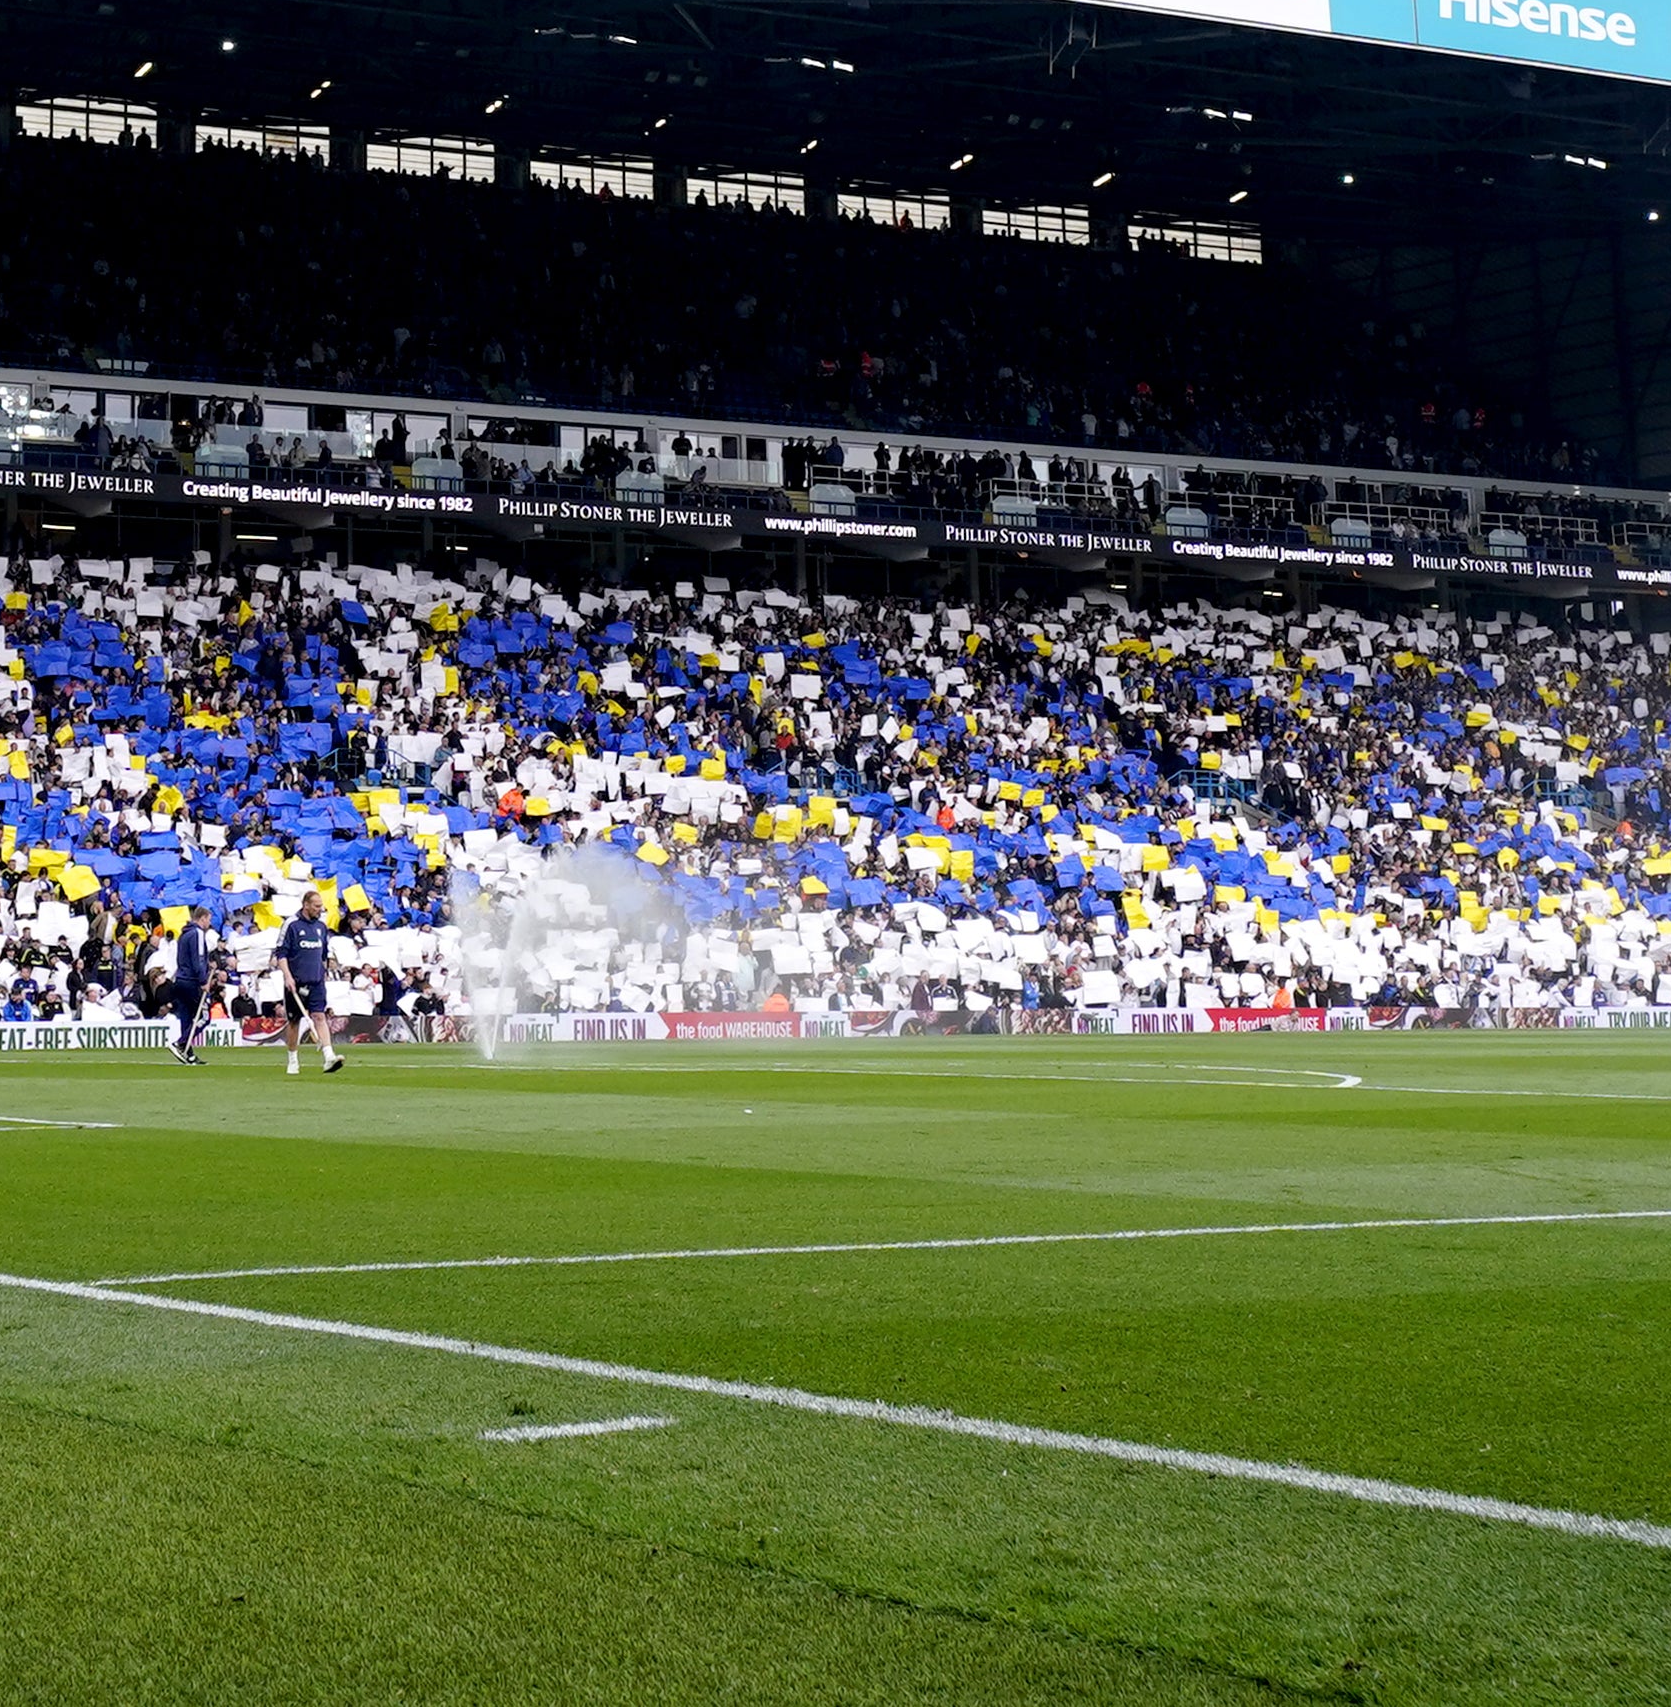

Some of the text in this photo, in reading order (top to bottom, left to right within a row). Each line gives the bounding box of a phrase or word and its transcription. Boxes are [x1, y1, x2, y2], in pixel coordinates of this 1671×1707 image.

[31, 472, 65, 488] THE
[68, 471, 154, 494] JEWELLER
[182, 480, 473, 512] Creating Beautiful Jewellery since 1982
[499, 497, 733, 528] PHILLIP STONER THE JEWELLER
[764, 517, 917, 538] www.phillipstoner.com
[945, 524, 1152, 553] PHILLIP STONER THE JEWELLER
[1172, 540, 1394, 567] Creating Beautiful Jewellery since 1982
[1412, 553, 1593, 578] PHILLIP STONER THE JEWELLER
[574, 1018, 646, 1040] FIND US IN
[676, 1021, 793, 1038] the food WAREHOUSE
[1132, 1013, 1194, 1033] FIND US IN
[1219, 1018, 1235, 1032] the
[1237, 1017, 1260, 1032] food
[1607, 1012, 1627, 1028] TRY
[1630, 1012, 1651, 1028] OUR
[77, 1026, 170, 1049] SUBSTITUTE
